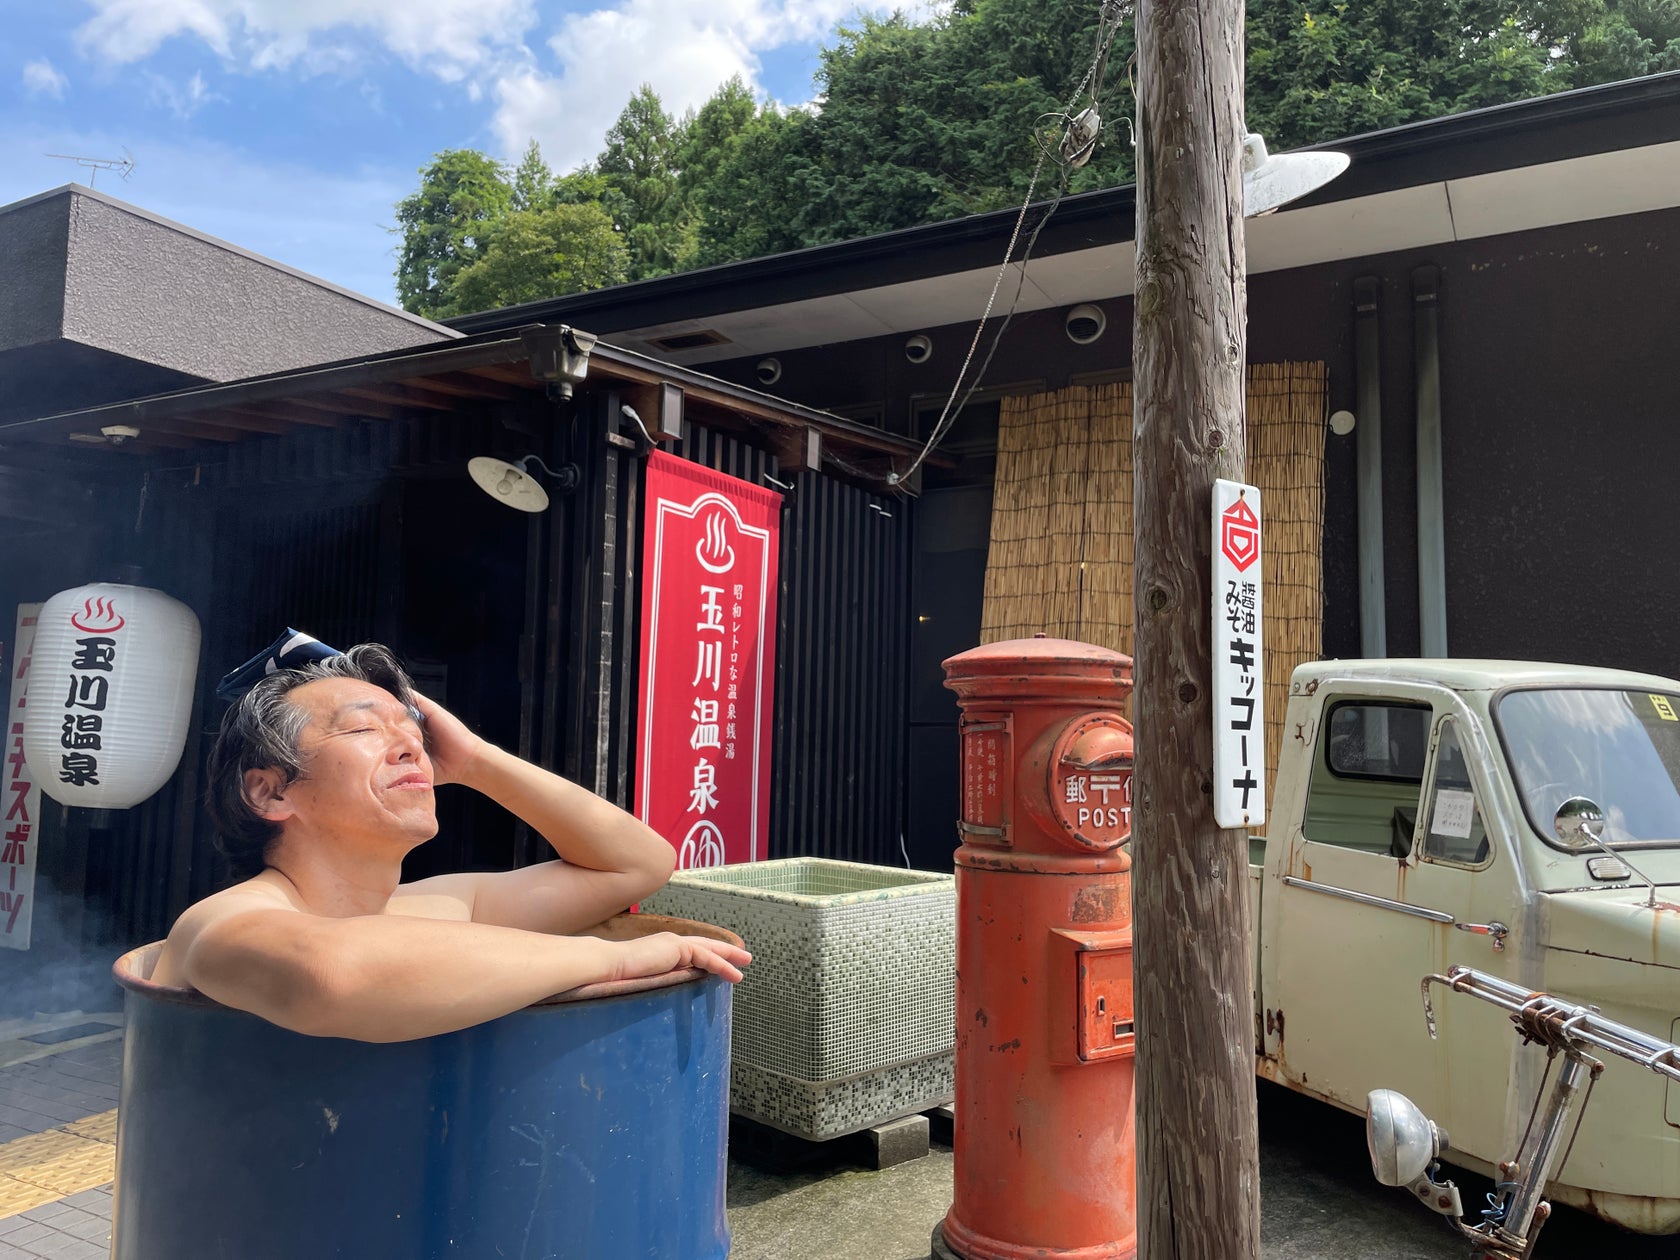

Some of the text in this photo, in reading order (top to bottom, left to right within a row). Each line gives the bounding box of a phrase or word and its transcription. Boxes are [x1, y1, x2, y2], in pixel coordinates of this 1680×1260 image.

[725, 583, 744, 760] 昭和レトロな温泉銭湯
[1226, 580, 1241, 633] みそ
[58, 636, 117, 787] 玉川温泉
[686, 584, 726, 815] 玉川温泉
[1229, 637, 1258, 810] キッコーナ
[1078, 806, 1132, 828] POST
